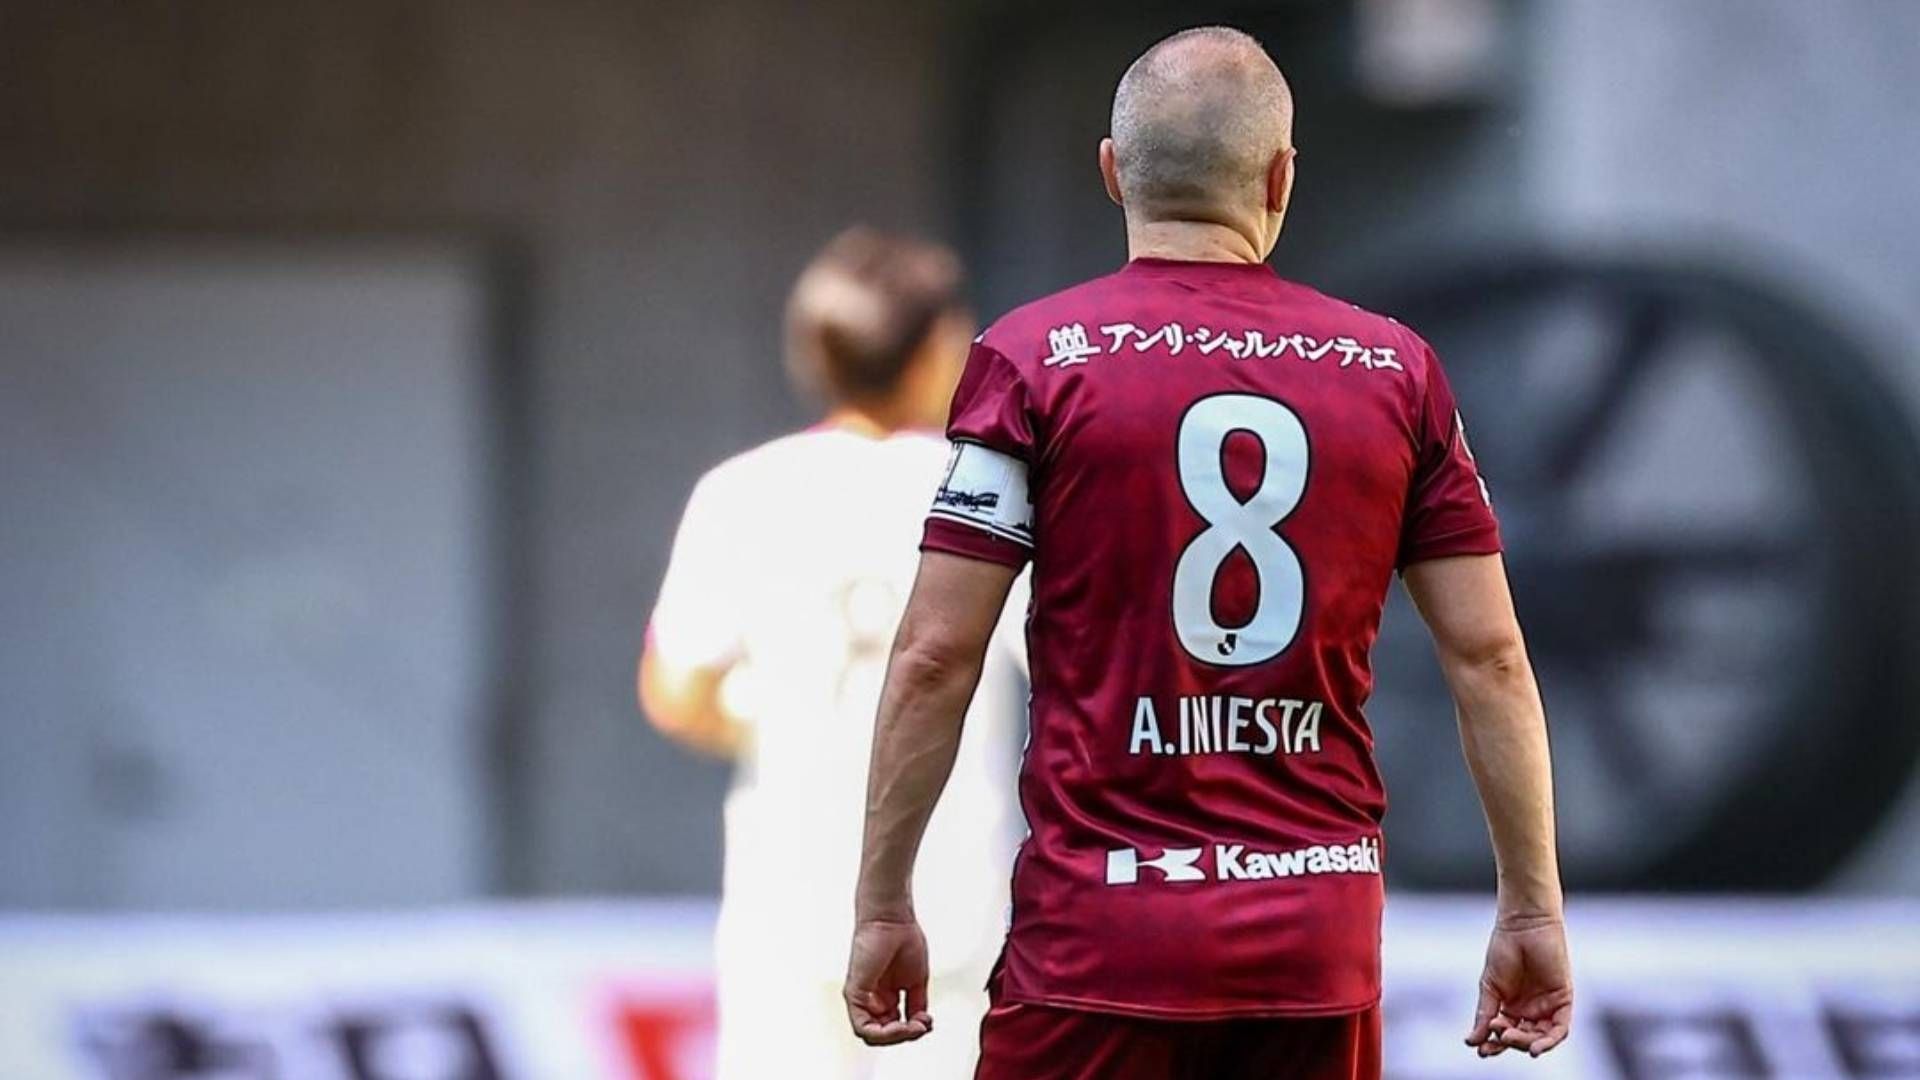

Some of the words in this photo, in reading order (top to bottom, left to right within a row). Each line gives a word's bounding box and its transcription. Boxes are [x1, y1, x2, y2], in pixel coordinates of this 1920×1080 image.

[1173, 392, 1310, 667] 8
[1129, 695, 1324, 755] A.INIESTA
[1215, 837, 1380, 881] Kawasaki
